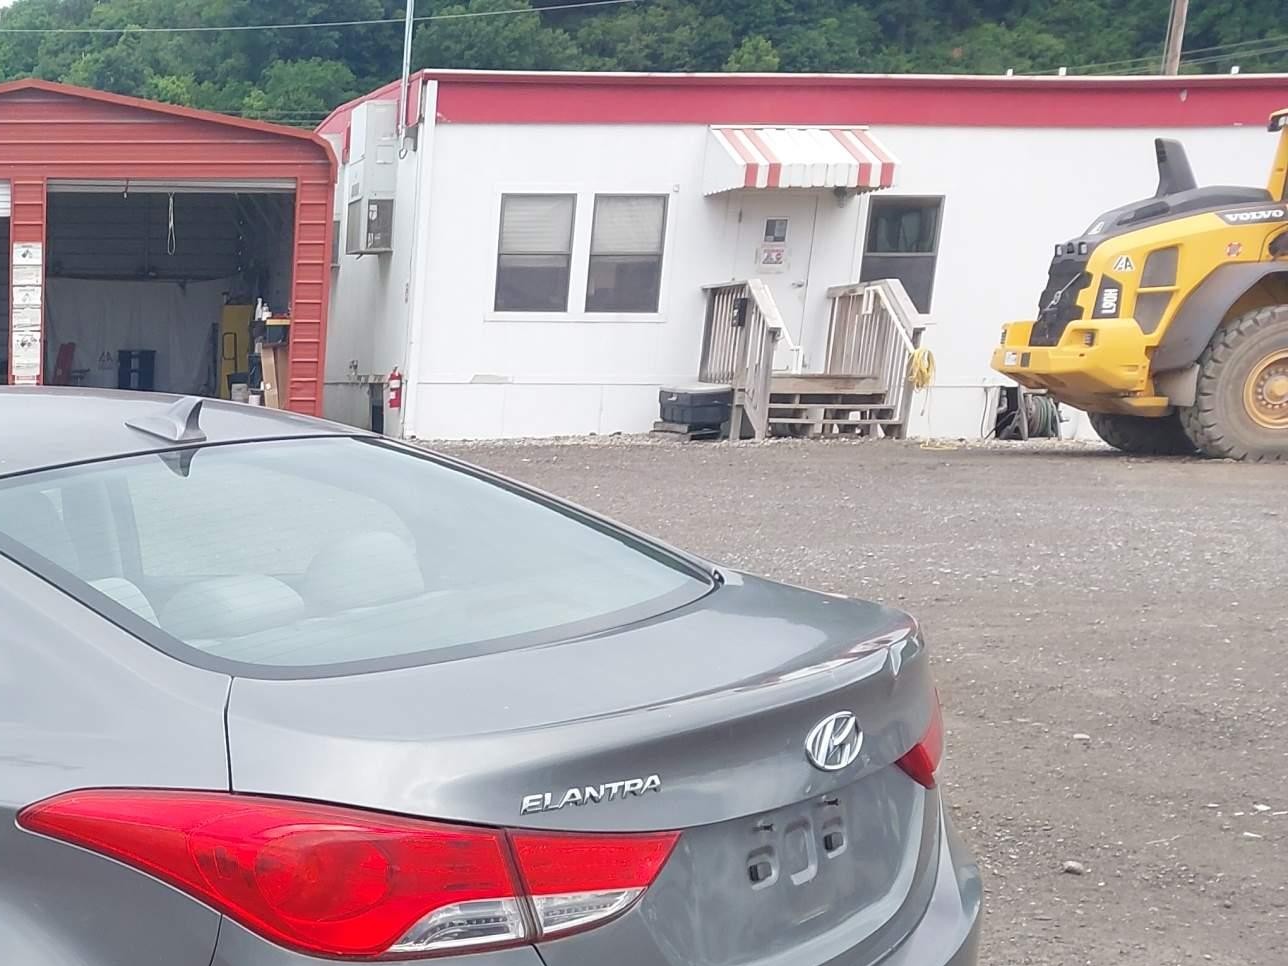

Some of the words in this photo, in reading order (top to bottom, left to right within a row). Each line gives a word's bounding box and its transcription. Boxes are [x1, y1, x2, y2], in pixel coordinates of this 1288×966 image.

[1224, 210, 1284, 221] VOLVO
[1101, 288, 1119, 314] L90H
[521, 774, 661, 815] ELANTRA
